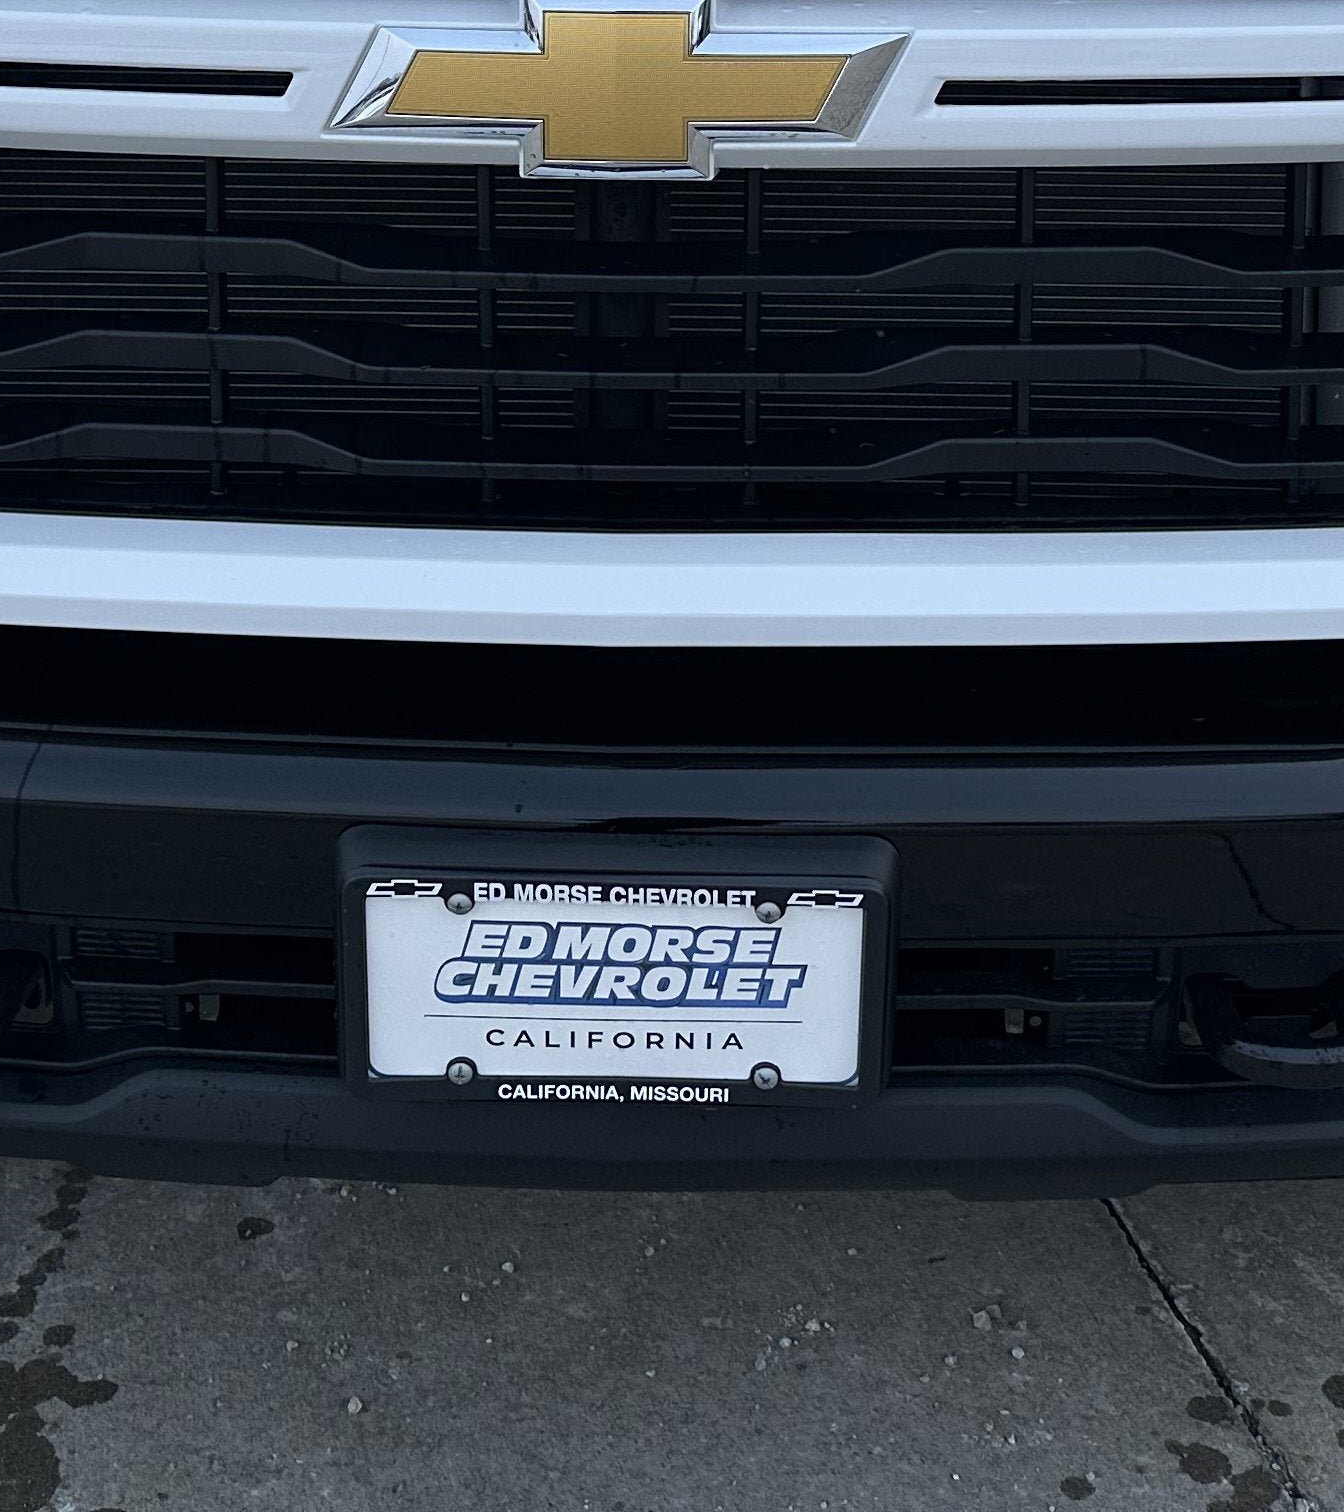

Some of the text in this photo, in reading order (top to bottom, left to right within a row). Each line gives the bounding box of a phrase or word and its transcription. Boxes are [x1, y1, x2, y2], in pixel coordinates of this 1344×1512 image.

[472, 882, 756, 909] ED MORSE CHEVROLET
[462, 920, 780, 964] ED MORSE
[435, 959, 806, 1005] CHEVROLET
[485, 1028, 744, 1051] CALIFORNIA
[497, 1084, 730, 1104] CALIFORNIA, MISSOURI
